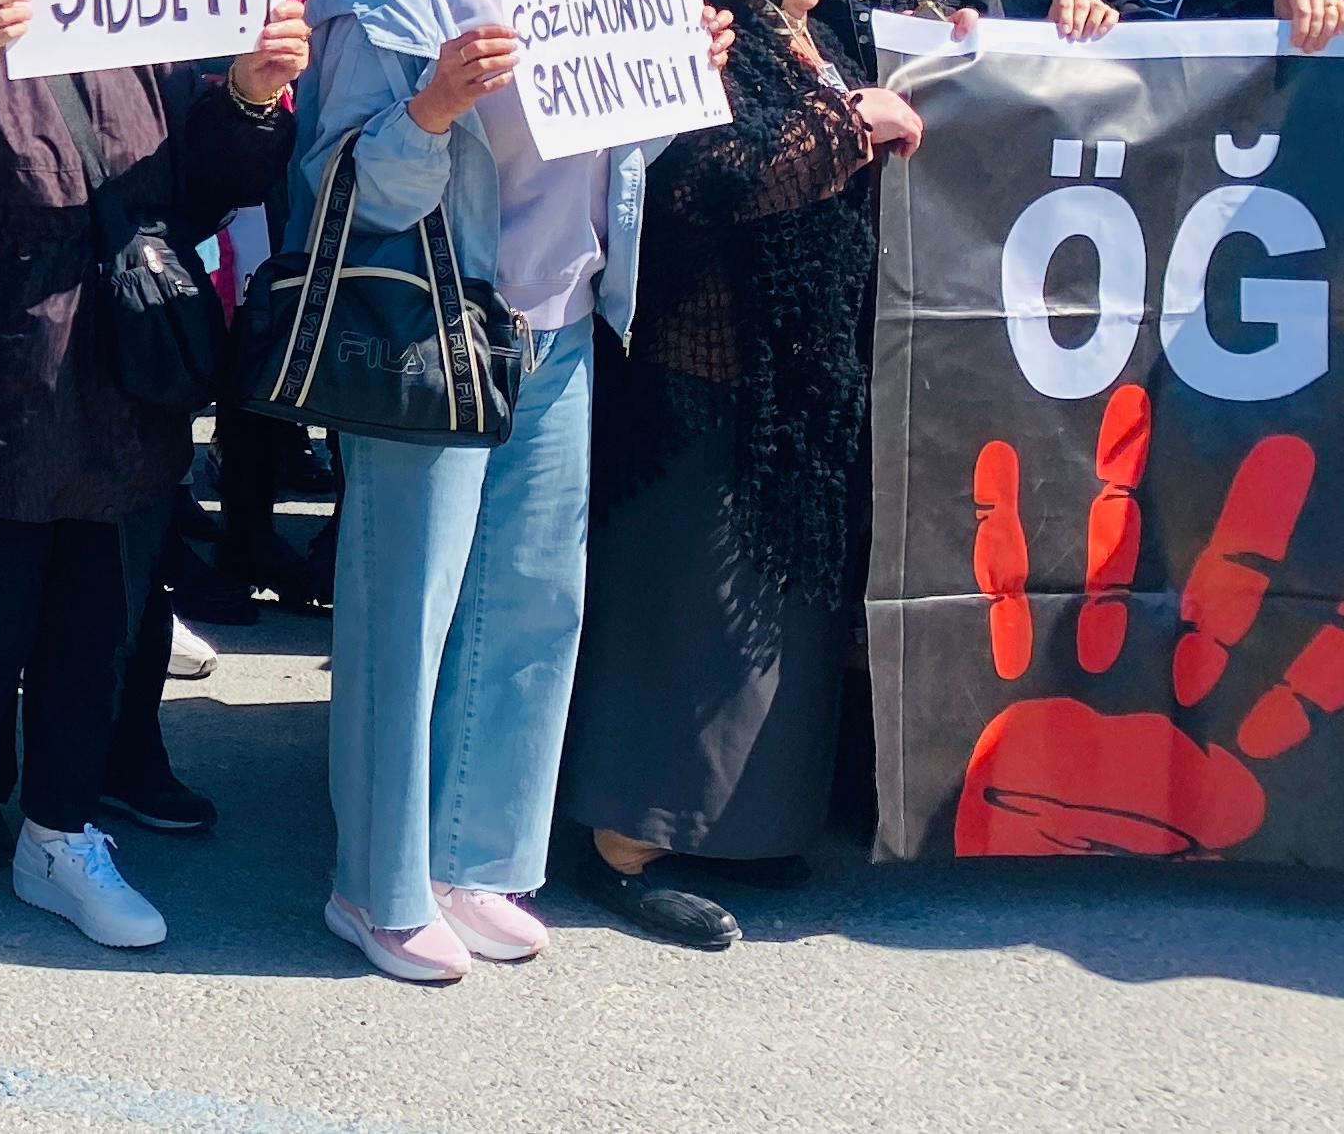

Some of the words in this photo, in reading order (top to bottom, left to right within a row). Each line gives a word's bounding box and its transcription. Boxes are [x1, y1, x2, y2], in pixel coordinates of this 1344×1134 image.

[533, 52, 624, 116] SAYIN
[331, 173, 352, 212] FILA
[320, 219, 342, 259] FILA
[431, 237, 452, 279] FILA
[310, 266, 331, 305] FILA
[1001, 134, 1329, 402] ÖĞ
[440, 285, 461, 326] FILA
[298, 312, 320, 352] FILA
[337, 330, 425, 375] FILA
[449, 333, 469, 375] FILA
[282, 359, 308, 399] FILA
[456, 383, 474, 424] FILA
